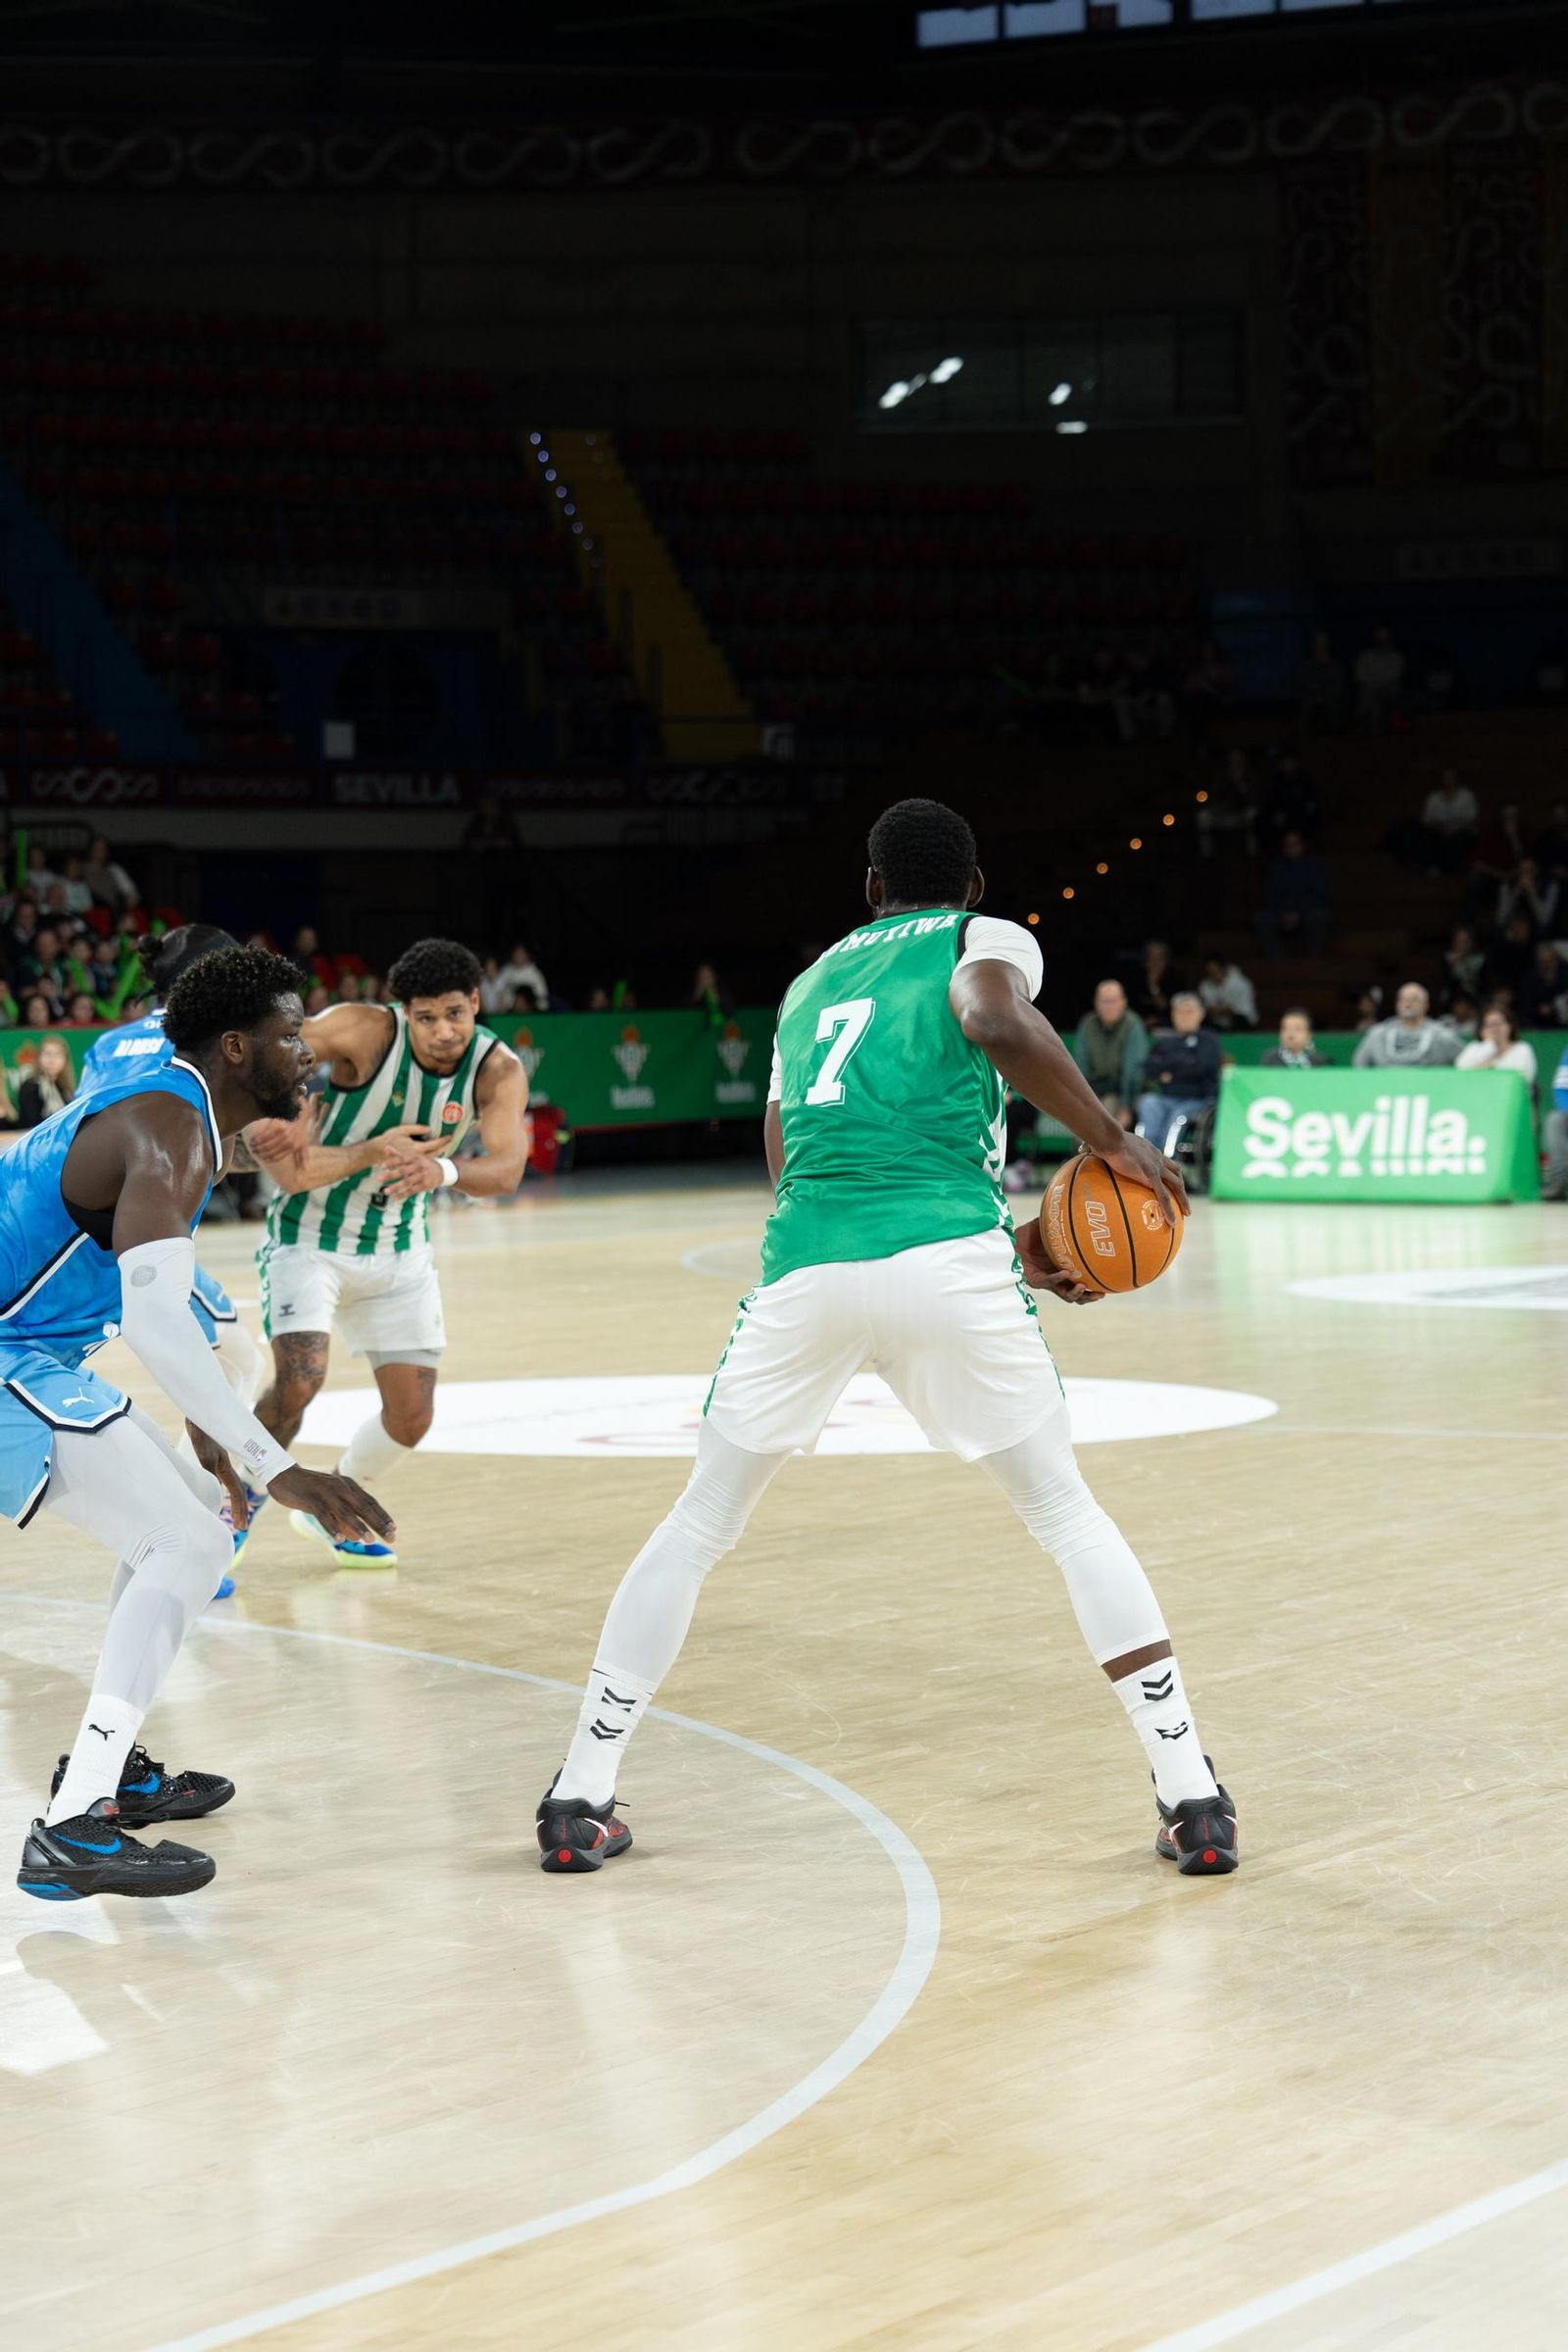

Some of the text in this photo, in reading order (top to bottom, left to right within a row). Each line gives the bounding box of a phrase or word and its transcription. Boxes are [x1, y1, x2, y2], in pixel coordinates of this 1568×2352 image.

[333, 772, 462, 804] SEVILLA
[805, 998, 875, 1107] 7
[1244, 1094, 1488, 1159] Sevilla.
[1085, 1200, 1116, 1257] EVO
